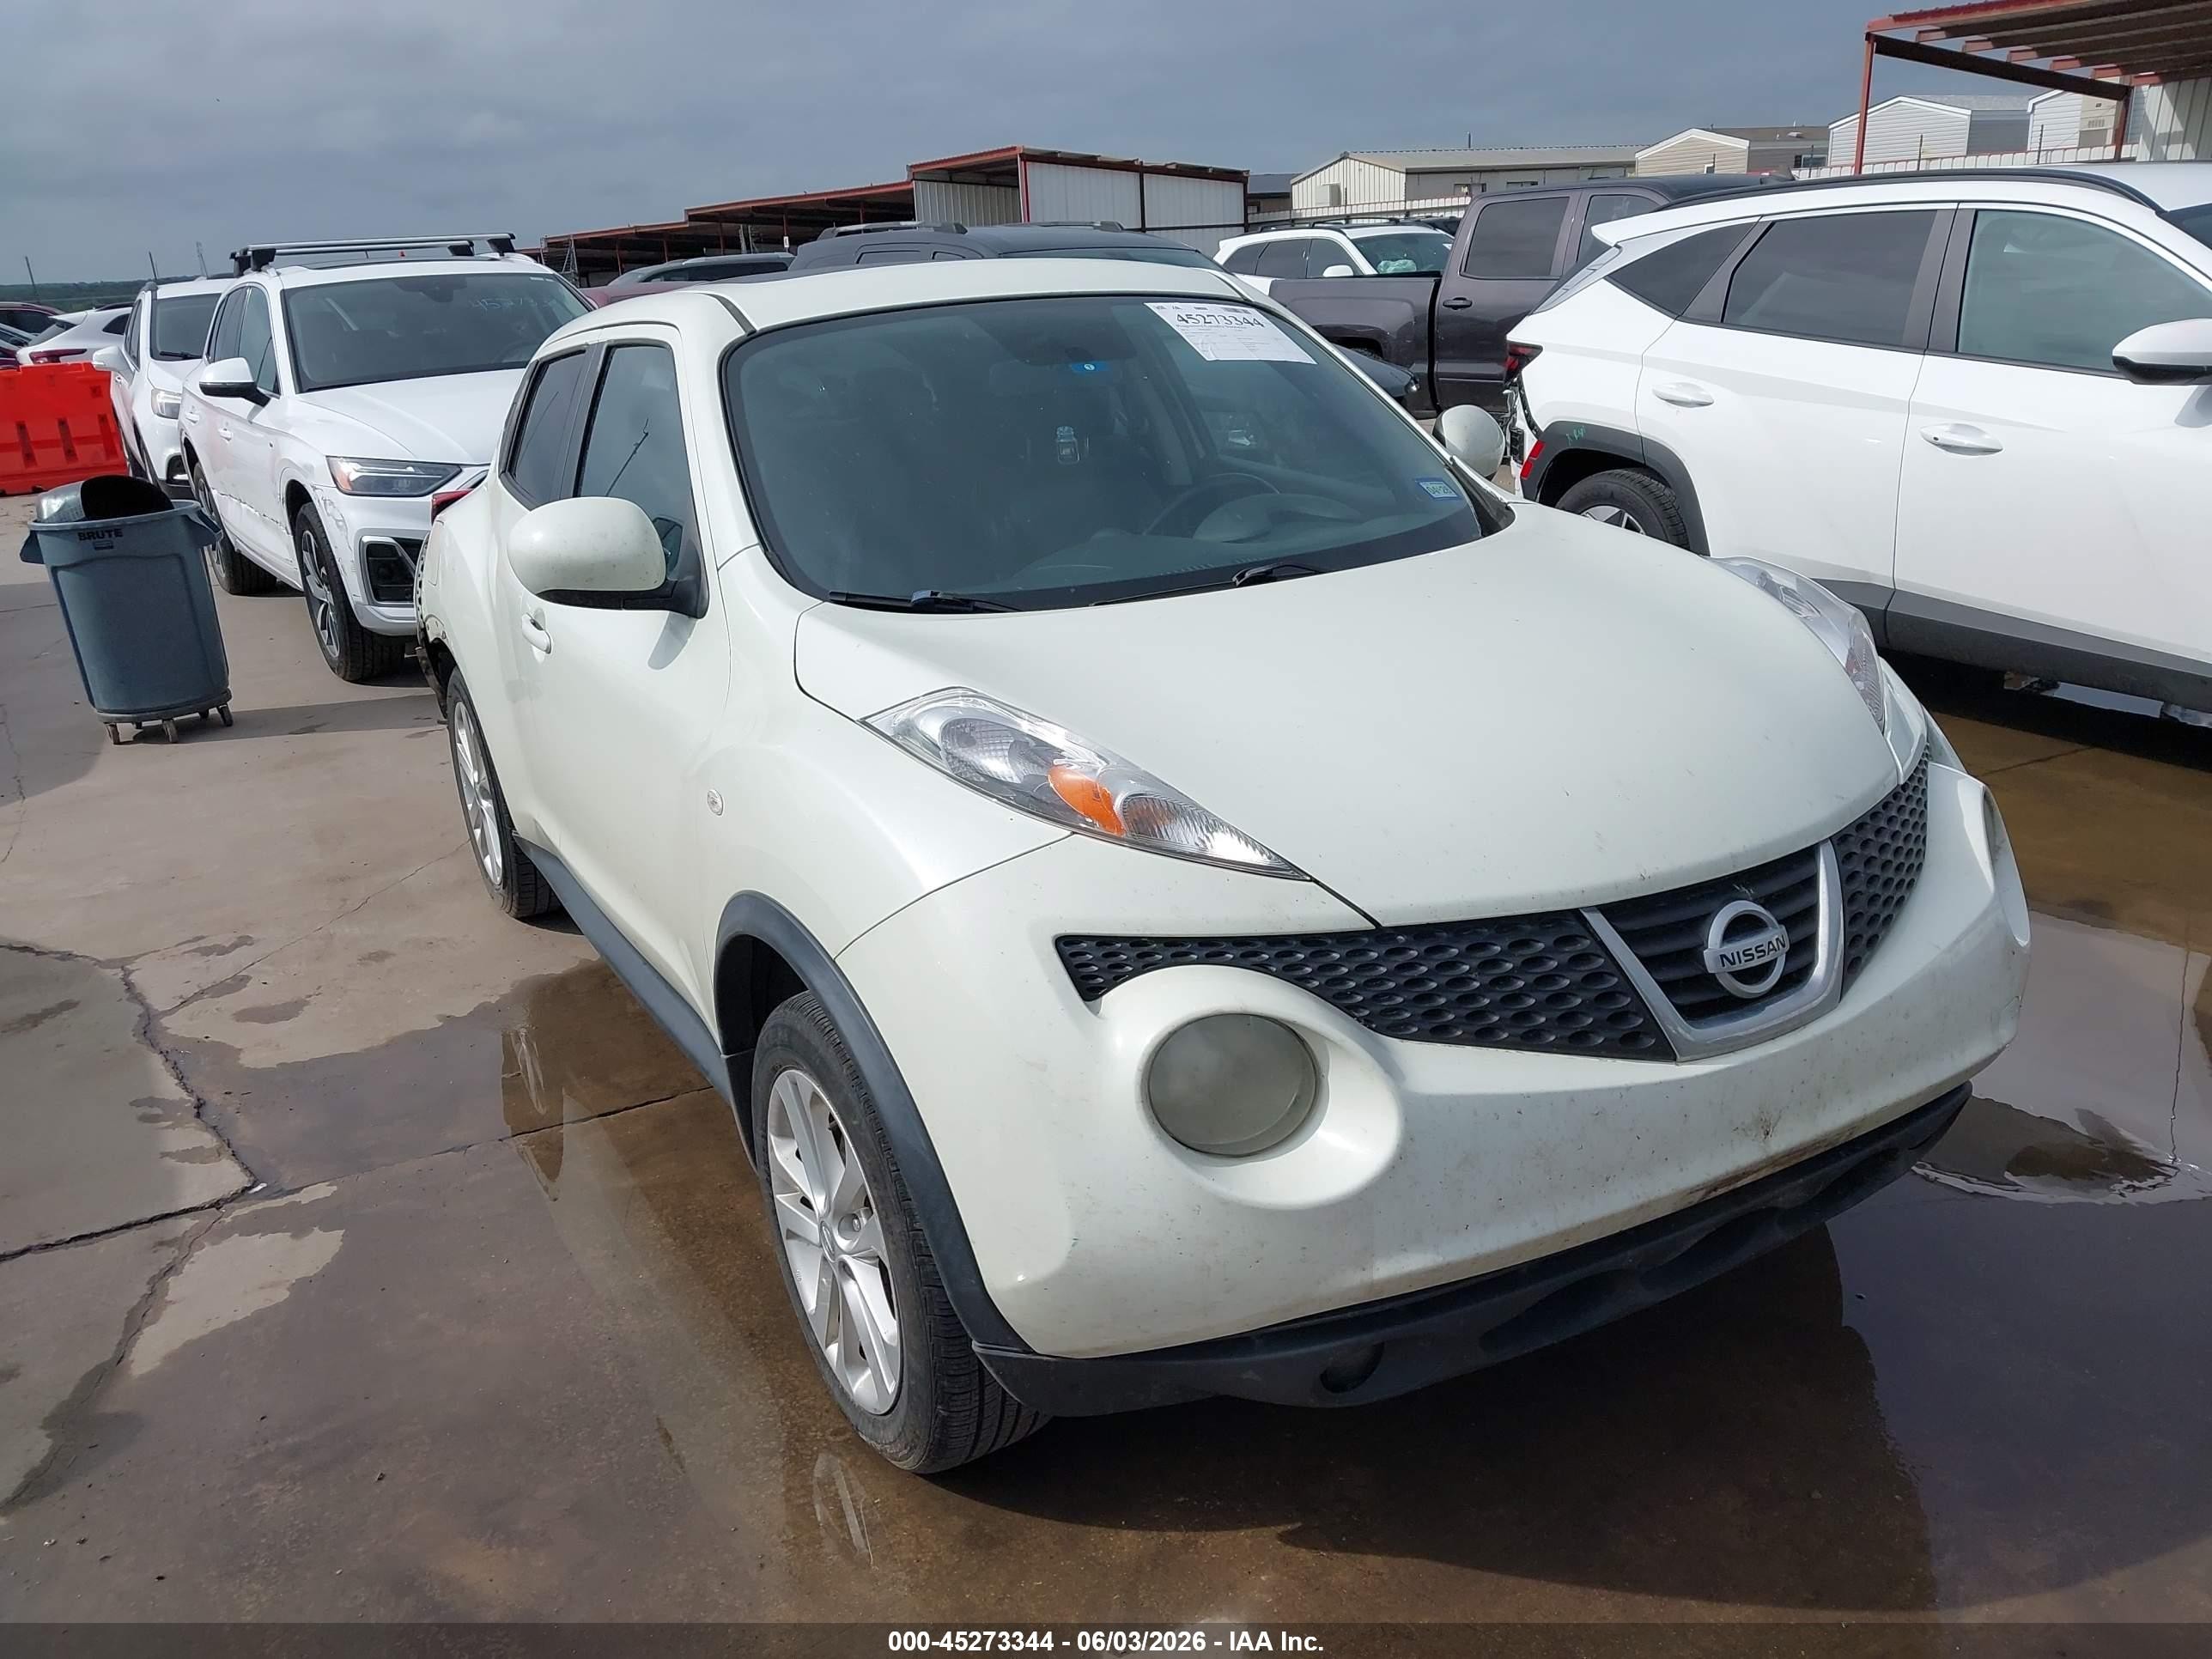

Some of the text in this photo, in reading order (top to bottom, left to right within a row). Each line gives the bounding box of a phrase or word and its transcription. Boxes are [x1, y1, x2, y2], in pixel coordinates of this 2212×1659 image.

[1176, 313, 1265, 327] 45273344
[77, 528, 124, 541] BRUTE
[1719, 933, 1787, 968] NISSAN
